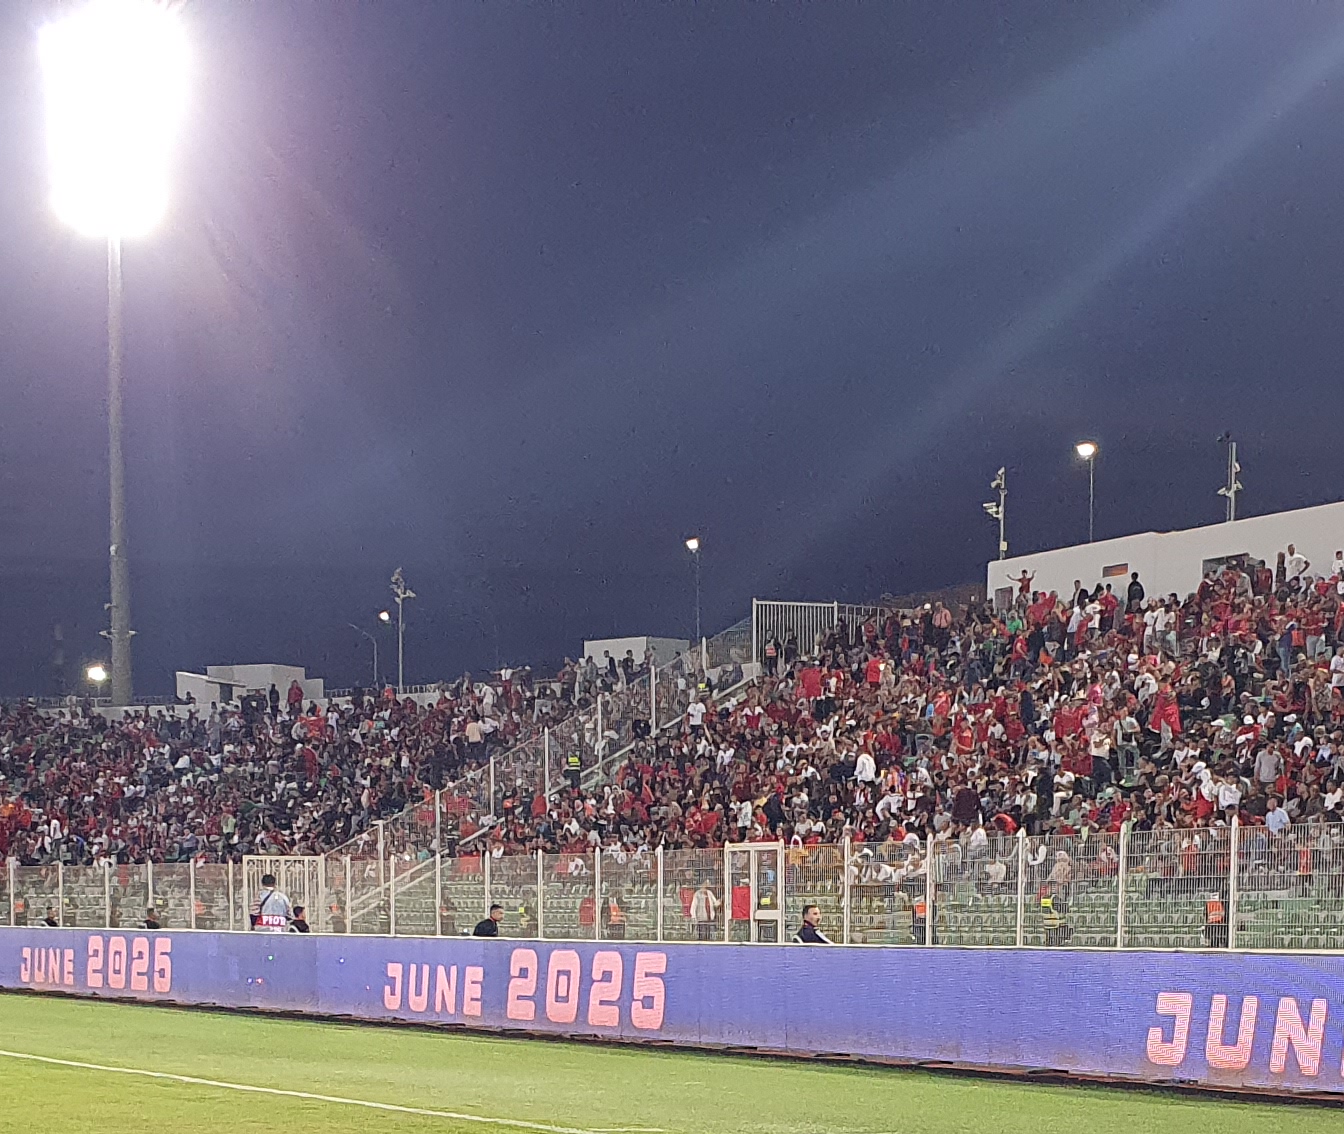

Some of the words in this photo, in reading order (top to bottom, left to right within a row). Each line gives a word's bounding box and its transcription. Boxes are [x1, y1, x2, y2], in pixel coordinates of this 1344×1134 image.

[21, 947, 75, 985] JUNE
[87, 935, 172, 993] 2025
[384, 962, 484, 1017] JUNE
[507, 948, 668, 1030] 2025
